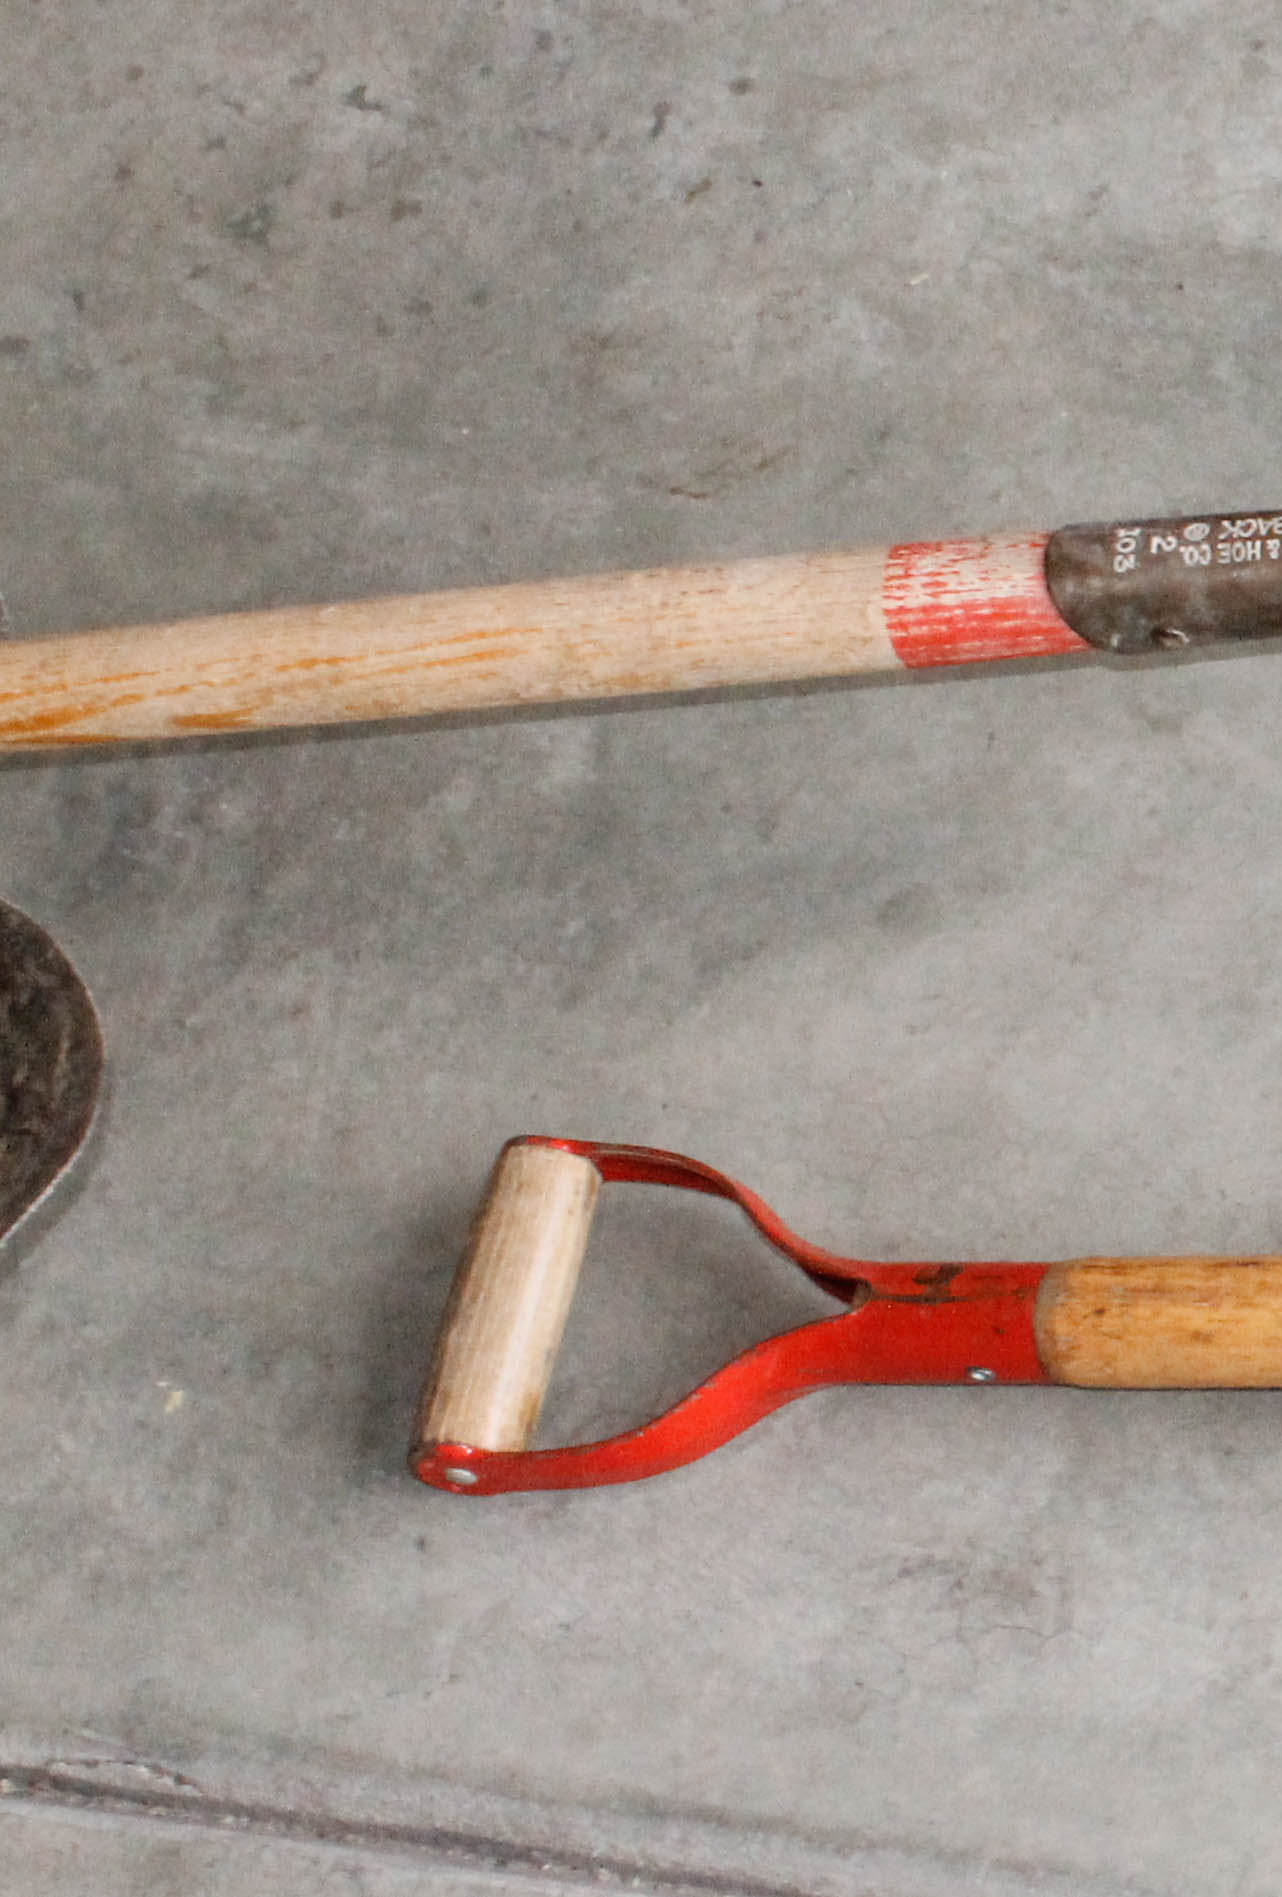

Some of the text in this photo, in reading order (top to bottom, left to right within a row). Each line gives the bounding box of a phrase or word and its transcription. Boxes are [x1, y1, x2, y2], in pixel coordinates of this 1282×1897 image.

[1112, 527, 1143, 574] 103
[1150, 535, 1178, 555] 2
[1178, 544, 1212, 567] CO.
[1216, 540, 1262, 564] HOE
[1266, 538, 1281, 560] &
